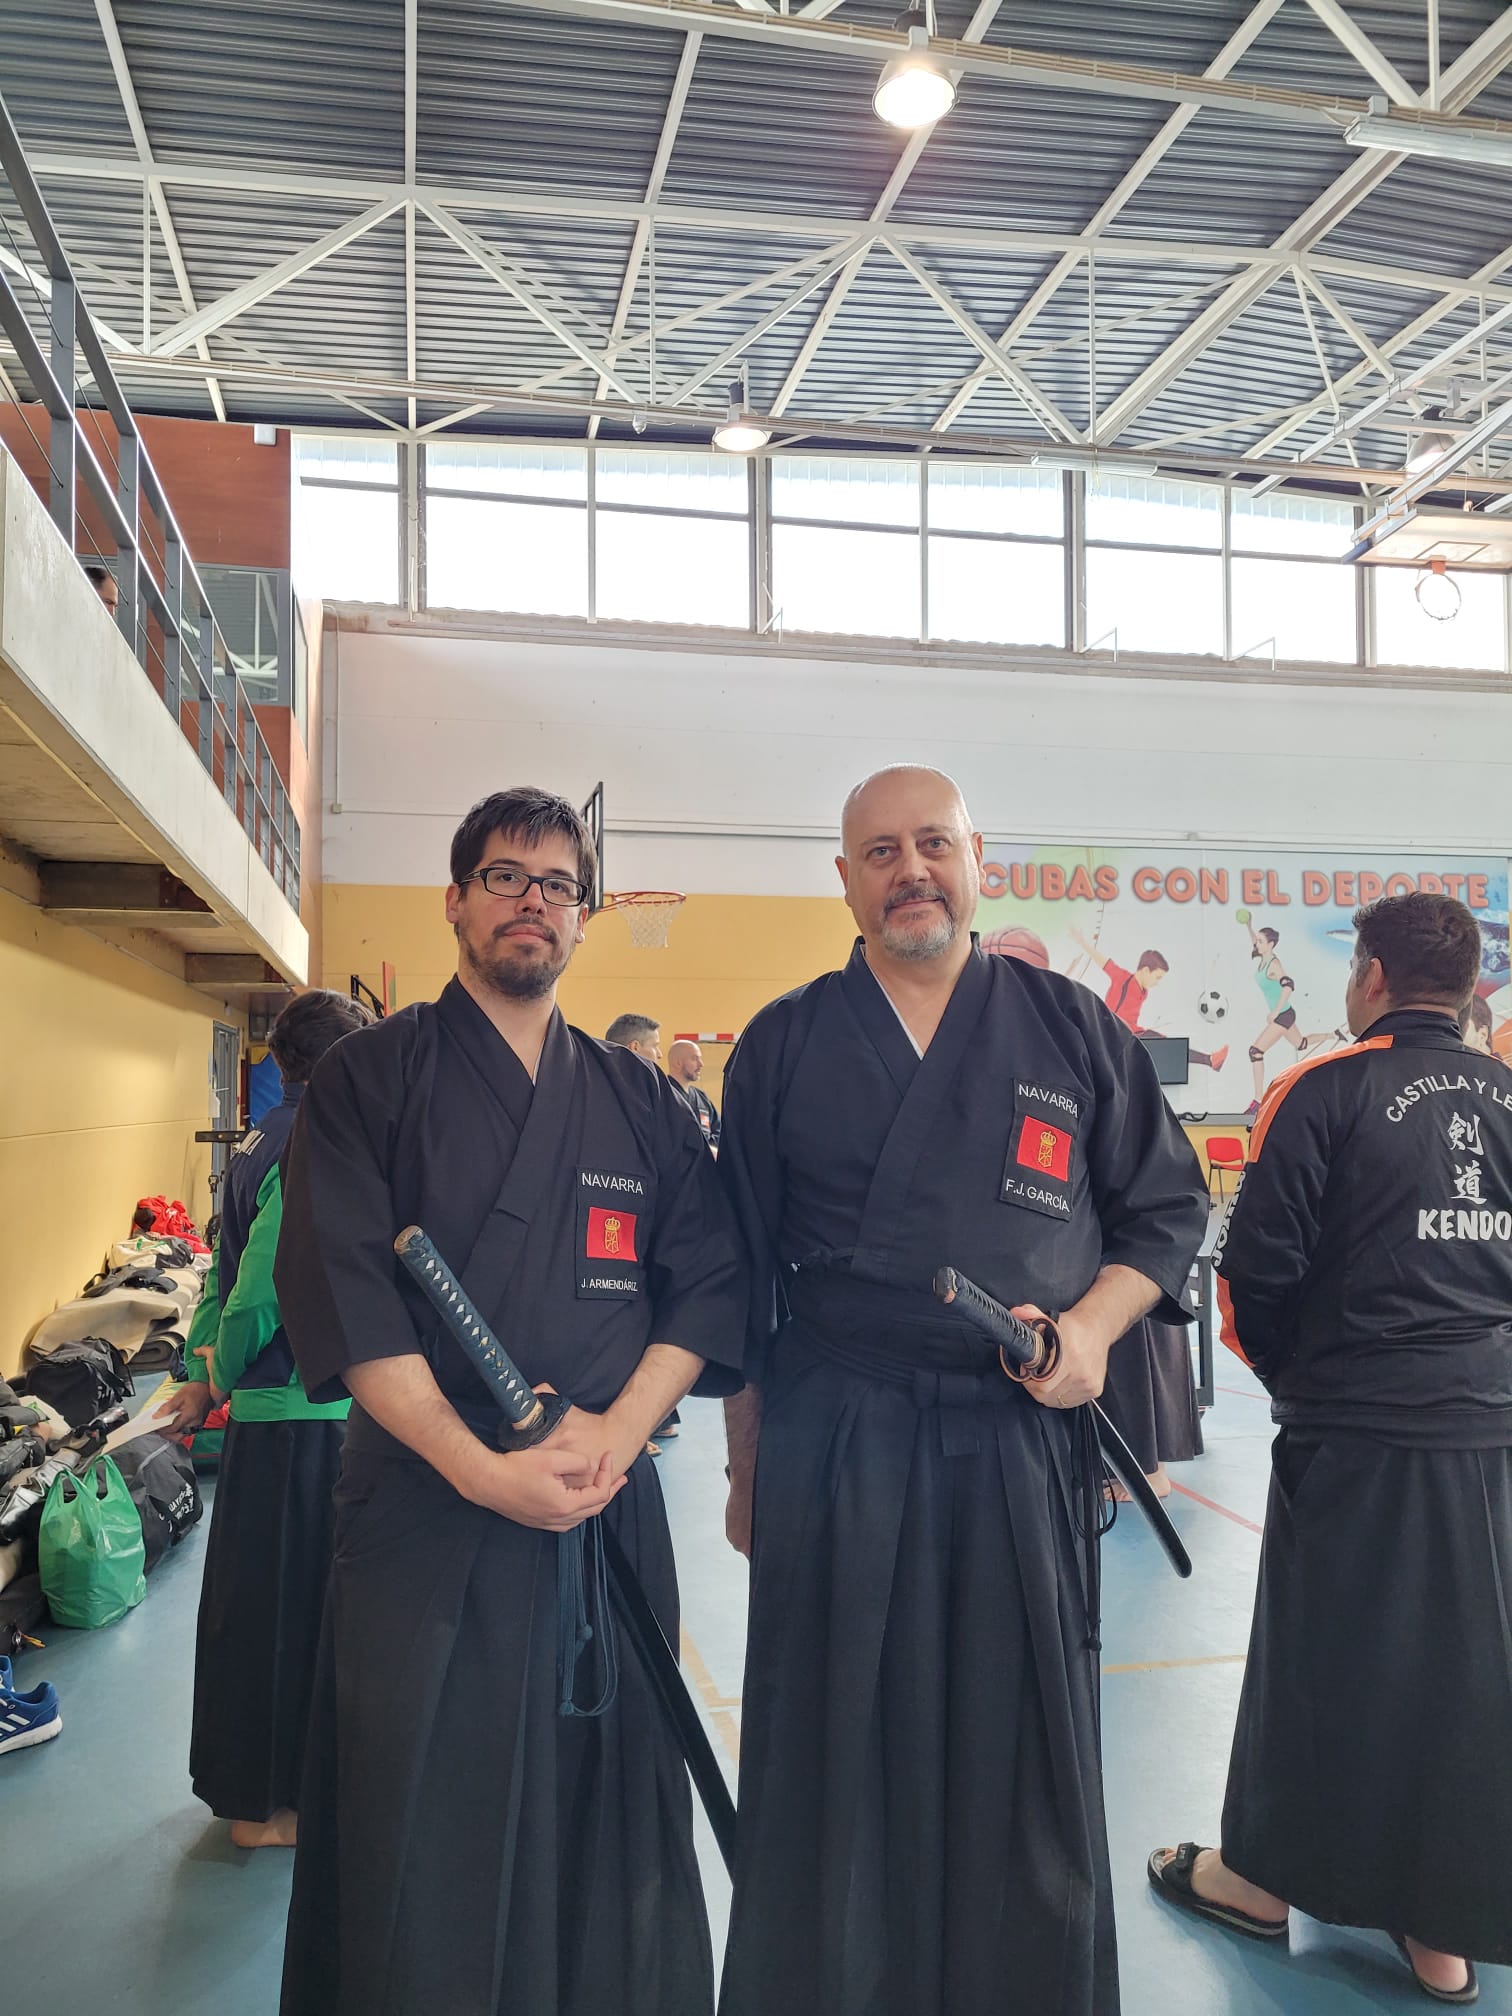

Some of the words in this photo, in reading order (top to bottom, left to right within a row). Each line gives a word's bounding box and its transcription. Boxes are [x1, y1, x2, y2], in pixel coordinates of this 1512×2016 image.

[980, 862, 1118, 901] CUBAS
[1132, 867, 1229, 904] CON
[1241, 868, 1290, 905] EL
[1302, 870, 1489, 908] DEPORTE
[1018, 1083, 1078, 1118] NAVARRA
[1386, 1074, 1471, 1123] CASTILLA
[1473, 1077, 1487, 1095] Y
[581, 1172, 644, 1195] NAVARRA
[1026, 1186, 1070, 1213] GARCÍA
[1417, 1208, 1512, 1241] KENDO
[589, 1278, 639, 1292] ARMENDÁRIZ
